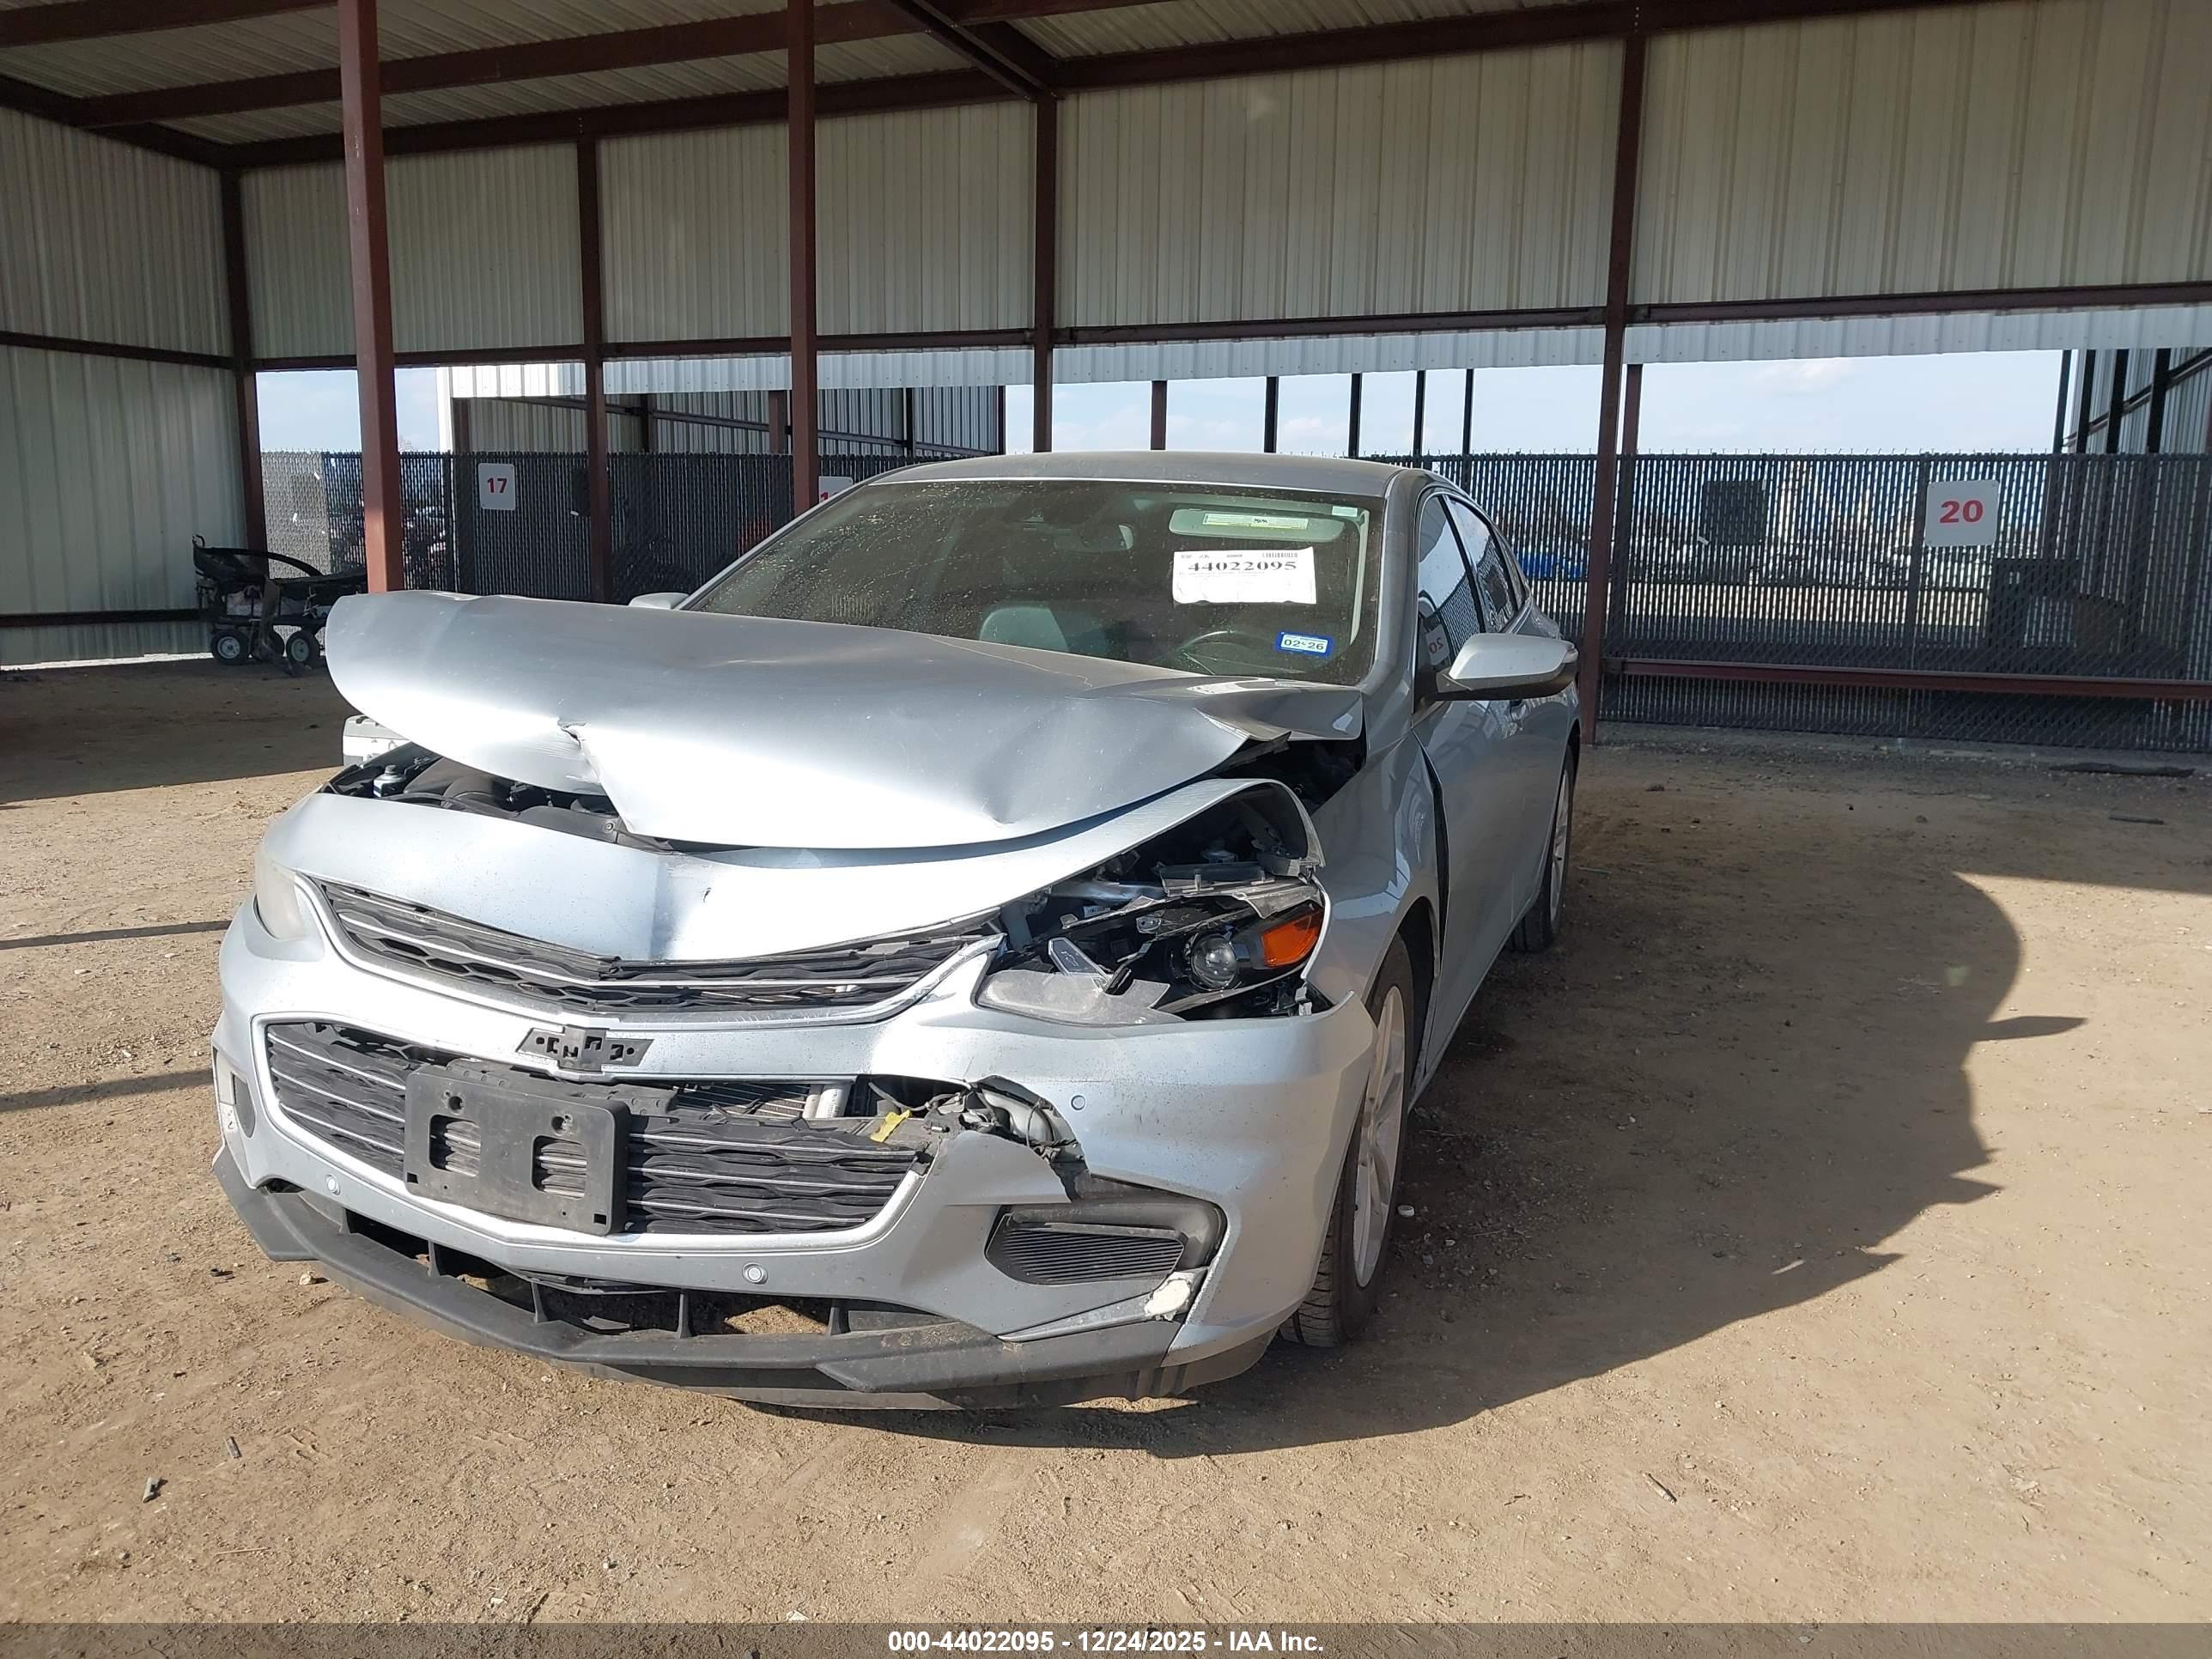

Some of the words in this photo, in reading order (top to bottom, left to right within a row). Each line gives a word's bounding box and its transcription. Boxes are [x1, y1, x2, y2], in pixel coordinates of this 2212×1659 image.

[487, 477, 507, 494] 17
[1939, 500, 1984, 524] 20
[1188, 561, 1297, 572] 44022095
